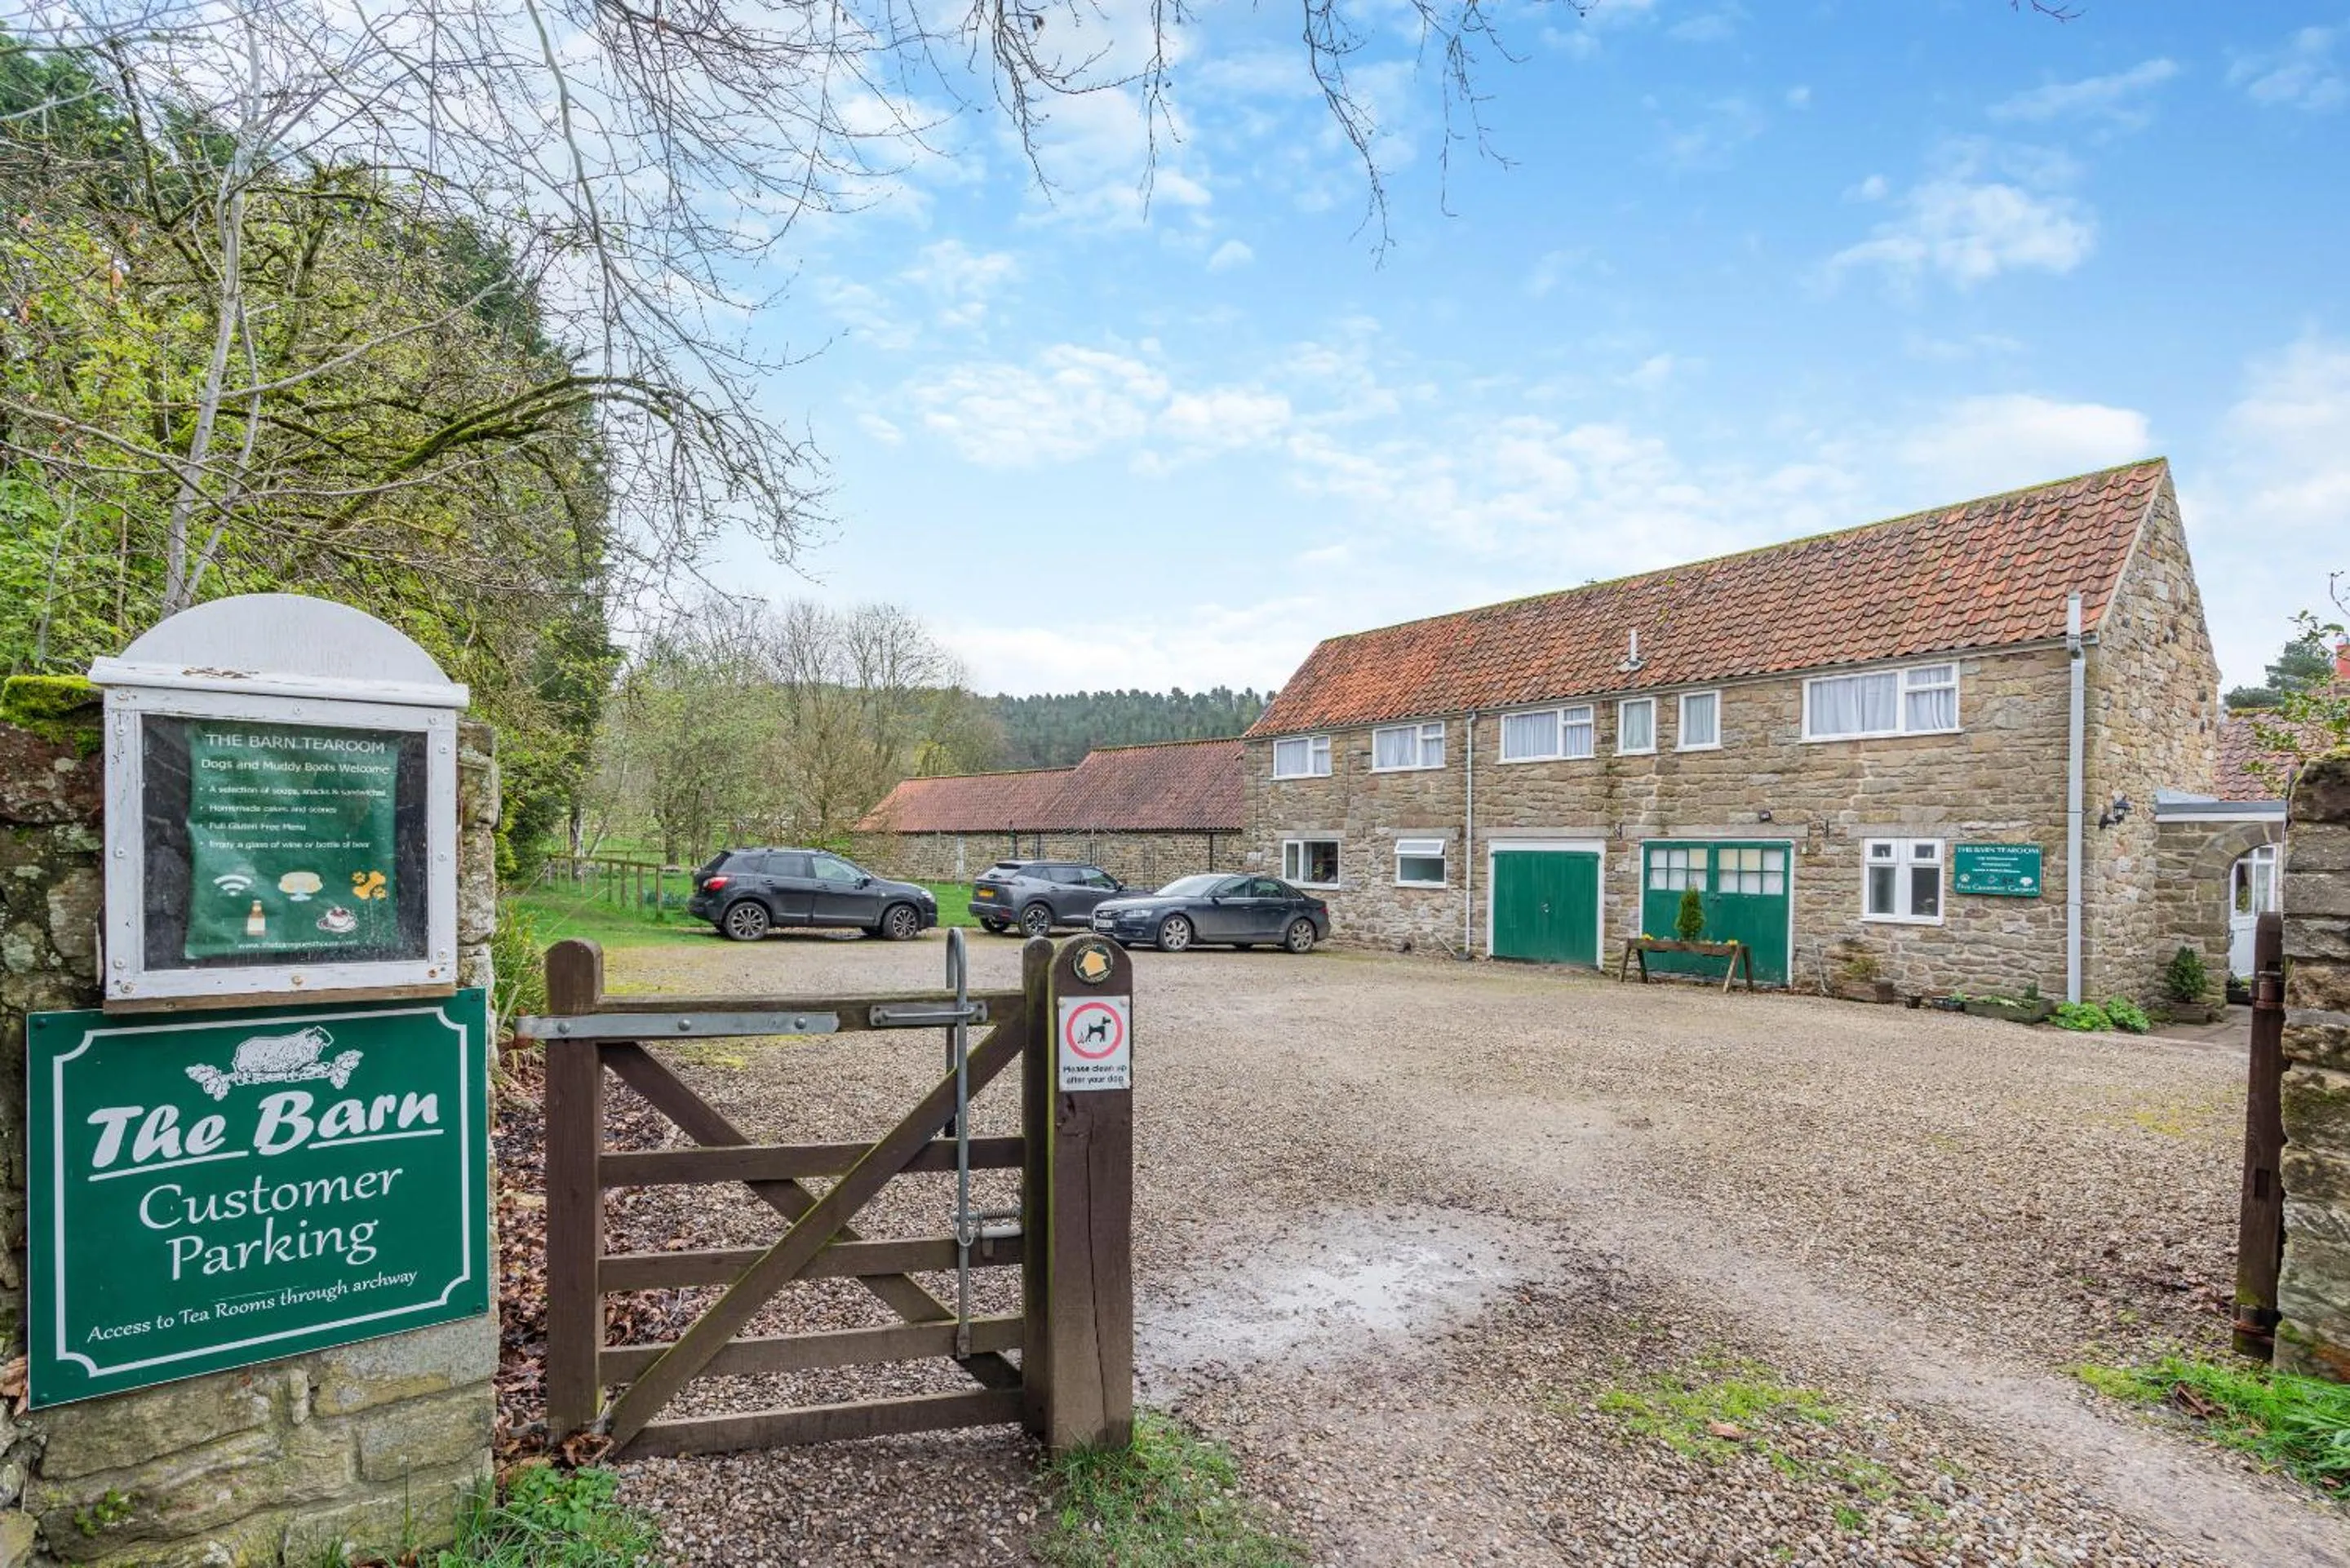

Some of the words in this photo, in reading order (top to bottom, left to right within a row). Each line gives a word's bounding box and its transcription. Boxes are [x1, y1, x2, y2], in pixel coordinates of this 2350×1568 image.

[206, 734, 243, 747] THE
[248, 735, 295, 749] BARN
[302, 737, 386, 754] TEAROOM
[202, 759, 233, 771] Dogs
[237, 760, 259, 770] and
[263, 761, 301, 773] Muddy
[304, 762, 336, 773] Boots
[339, 764, 391, 775] Welcome
[209, 786, 216, 794] A
[218, 786, 258, 794] selection
[260, 786, 269, 794] of
[210, 804, 261, 813] Homemade
[263, 804, 289, 813] cakes
[290, 805, 307, 813] and
[308, 806, 338, 814] scones
[209, 822, 227, 830] Full
[228, 822, 258, 831] Gluten
[260, 822, 280, 831] Free
[282, 823, 307, 831] Menu
[209, 839, 235, 850] Enjoy
[245, 841, 268, 850] glass
[270, 840, 279, 848] of
[316, 840, 340, 848] bottle
[342, 840, 351, 848] of
[352, 840, 370, 848] beer
[1063, 1065, 1089, 1073] Please
[1092, 1064, 1115, 1073] clean
[1066, 1076, 1085, 1084] after
[1088, 1077, 1106, 1085] your
[1107, 1075, 1124, 1084] dog
[87, 1104, 227, 1169] The
[253, 1090, 440, 1157] Barn
[138, 1167, 404, 1230] Customer
[165, 1216, 379, 1282] Parking
[86, 1319, 151, 1344] Access
[155, 1313, 175, 1331] to
[179, 1309, 211, 1325] Tea
[214, 1296, 276, 1320] Rooms
[280, 1281, 349, 1307] through
[352, 1268, 419, 1295] archway
